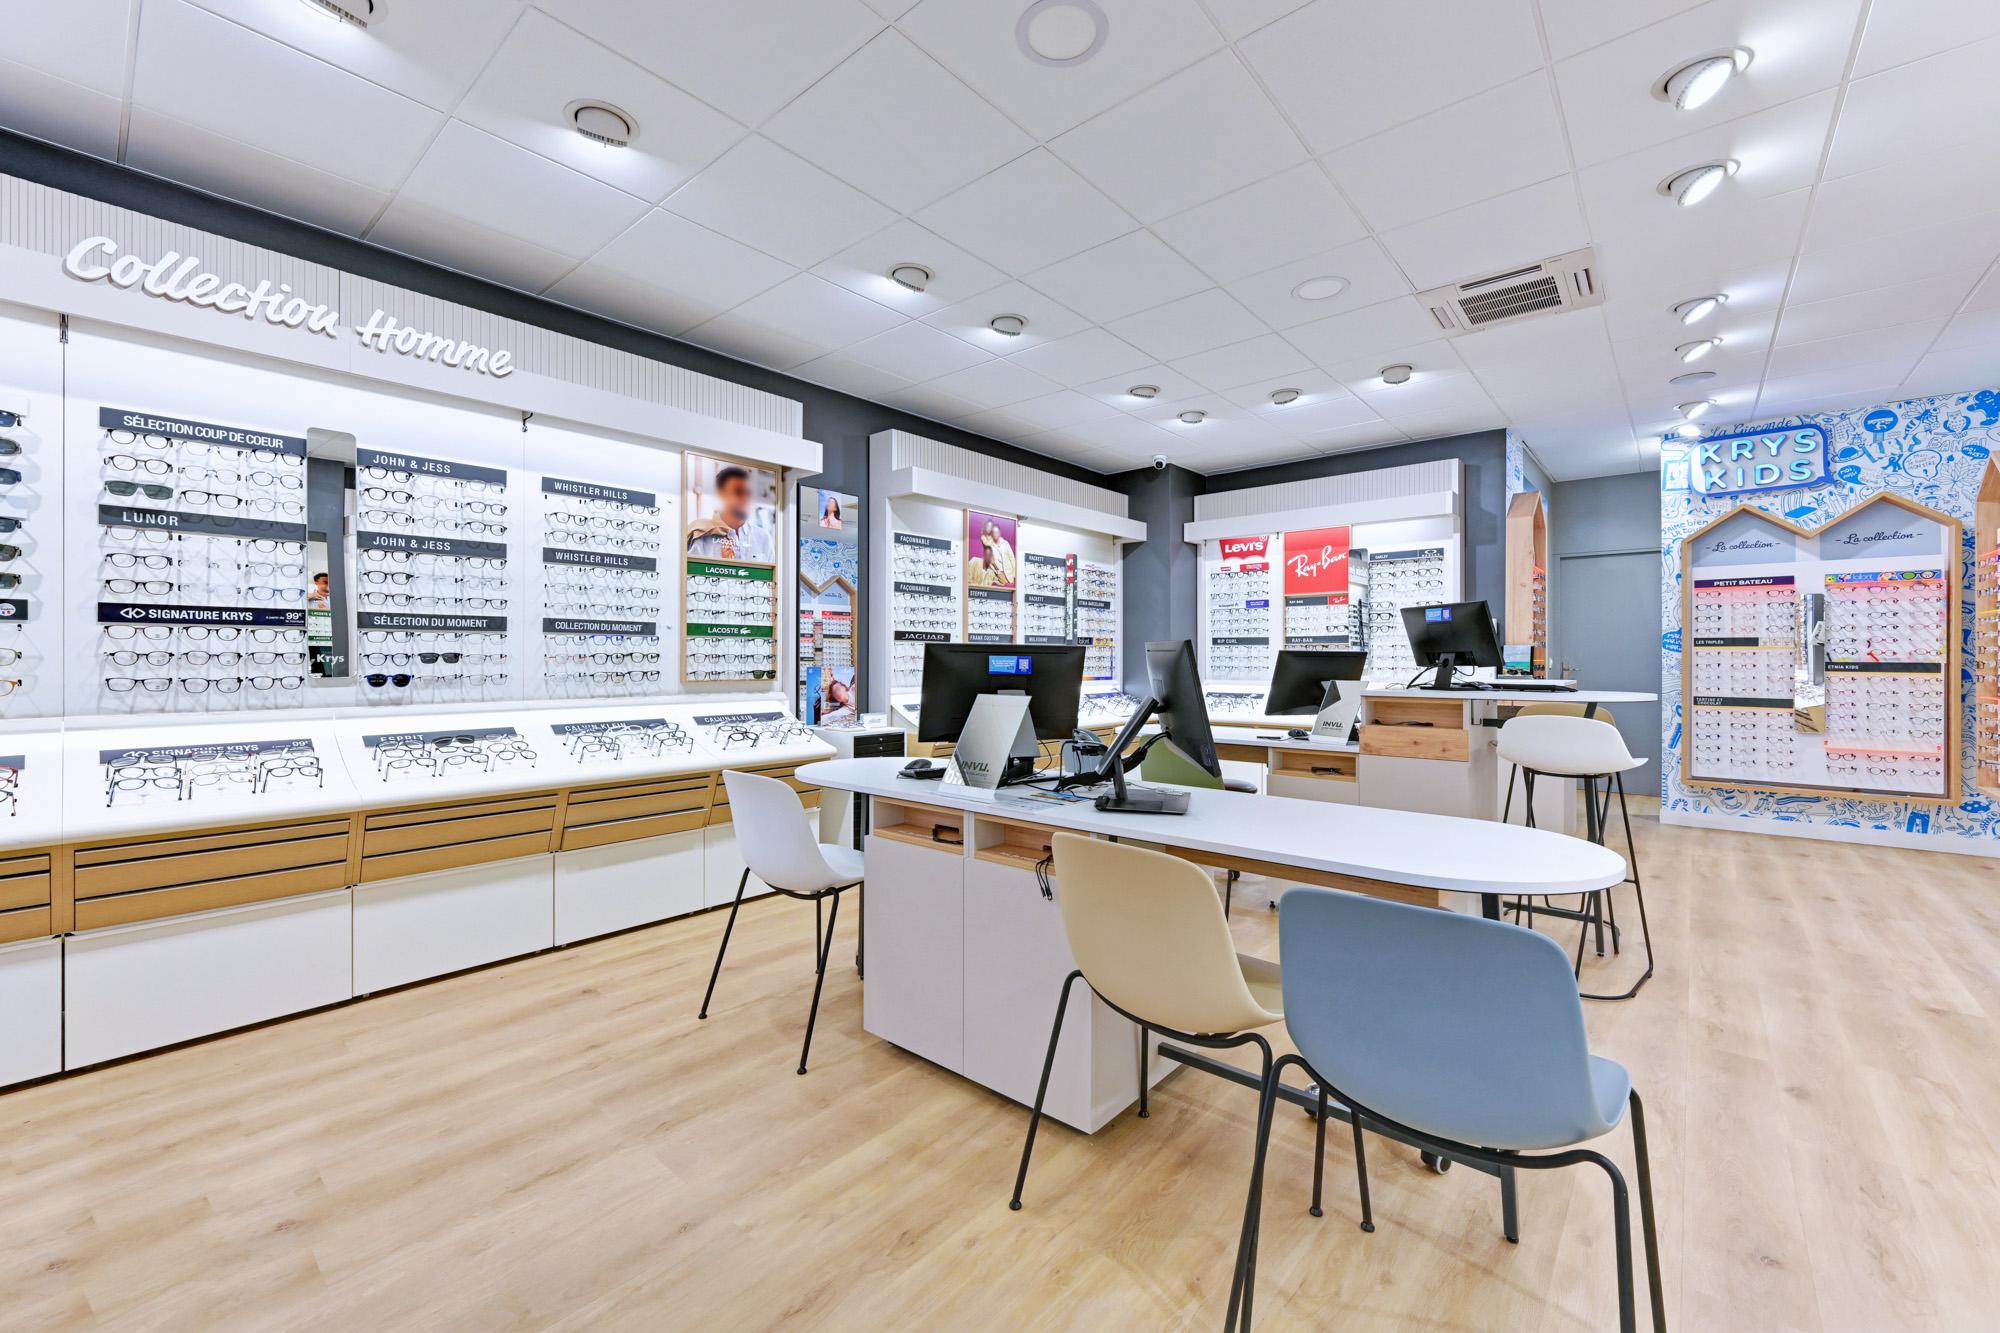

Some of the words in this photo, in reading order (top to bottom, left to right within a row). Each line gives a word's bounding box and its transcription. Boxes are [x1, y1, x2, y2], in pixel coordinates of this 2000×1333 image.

[64, 236, 339, 338] Collection
[355, 309, 514, 378] Homme
[123, 415, 193, 435] SÉLECTION
[194, 426, 227, 440] COUP
[229, 431, 244, 443] DE
[246, 434, 284, 449] COEUR
[1700, 431, 1817, 465] KRYS
[373, 454, 406, 467] JOHN
[410, 460, 418, 469] &
[422, 461, 451, 474] JESS
[1705, 459, 1813, 490] KIDS
[554, 481, 600, 496] WHISTLER
[603, 489, 628, 500] HILLS
[122, 511, 179, 526] LUNOR
[373, 536, 406, 547] JOHN
[410, 539, 418, 548] &
[422, 541, 451, 551] JESS
[900, 535, 930, 546] FAÇONNABLE
[1843, 533, 1860, 545] La
[1861, 531, 1915, 543] collection
[1712, 541, 1727, 552] La
[1728, 541, 1774, 550] collection
[555, 551, 601, 564] WHISTLER
[604, 555, 629, 566] HILLS
[705, 566, 737, 576] LACOSTE
[1738, 578, 1773, 586] BATEAU
[900, 584, 930, 593] FAÇONNABLE
[148, 609, 220, 620] SIGNATURE
[222, 611, 253, 621] KRYS
[374, 615, 428, 627] SÉLECTION
[431, 618, 445, 627] DU
[446, 618, 488, 628] MOMENT
[555, 621, 600, 631] COLLECTION
[600, 623, 611, 631] DU
[611, 623, 643, 632] MOMENT
[707, 626, 739, 634] LACOSTE
[316, 653, 345, 665] Krys
[565, 724, 598, 732] CALVIN
[601, 722, 626, 730] KLEIN
[228, 744, 259, 753] KRYS
